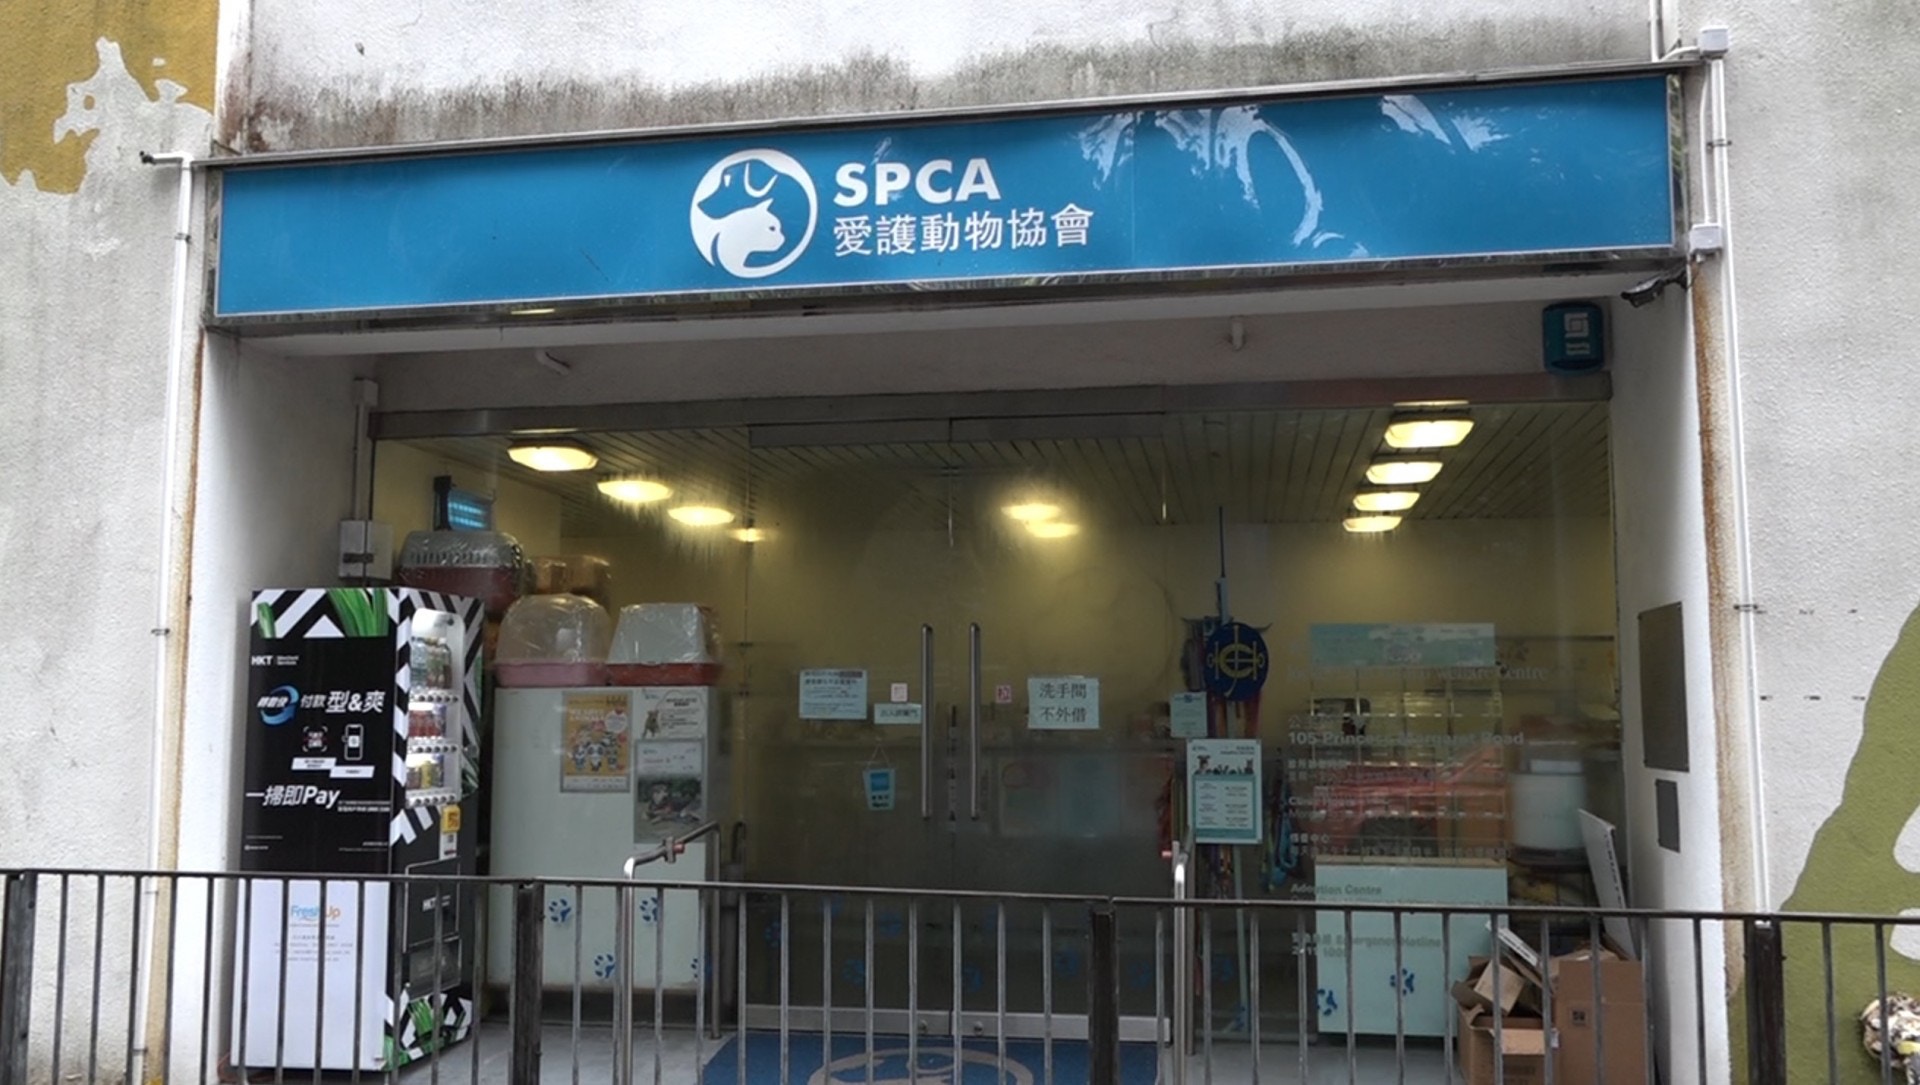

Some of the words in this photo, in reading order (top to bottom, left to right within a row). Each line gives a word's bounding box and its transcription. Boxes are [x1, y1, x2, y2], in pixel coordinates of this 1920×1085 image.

[833, 157, 1001, 208] SPCA
[833, 202, 1094, 258] 愛護動物協會
[251, 655, 273, 666] HKT
[1039, 682, 1087, 699] 洗手間
[1040, 706, 1087, 723] 不外借
[1288, 732, 1315, 744] 105
[1345, 884, 1382, 894] Centre
[1337, 935, 1399, 947] Eergenc
